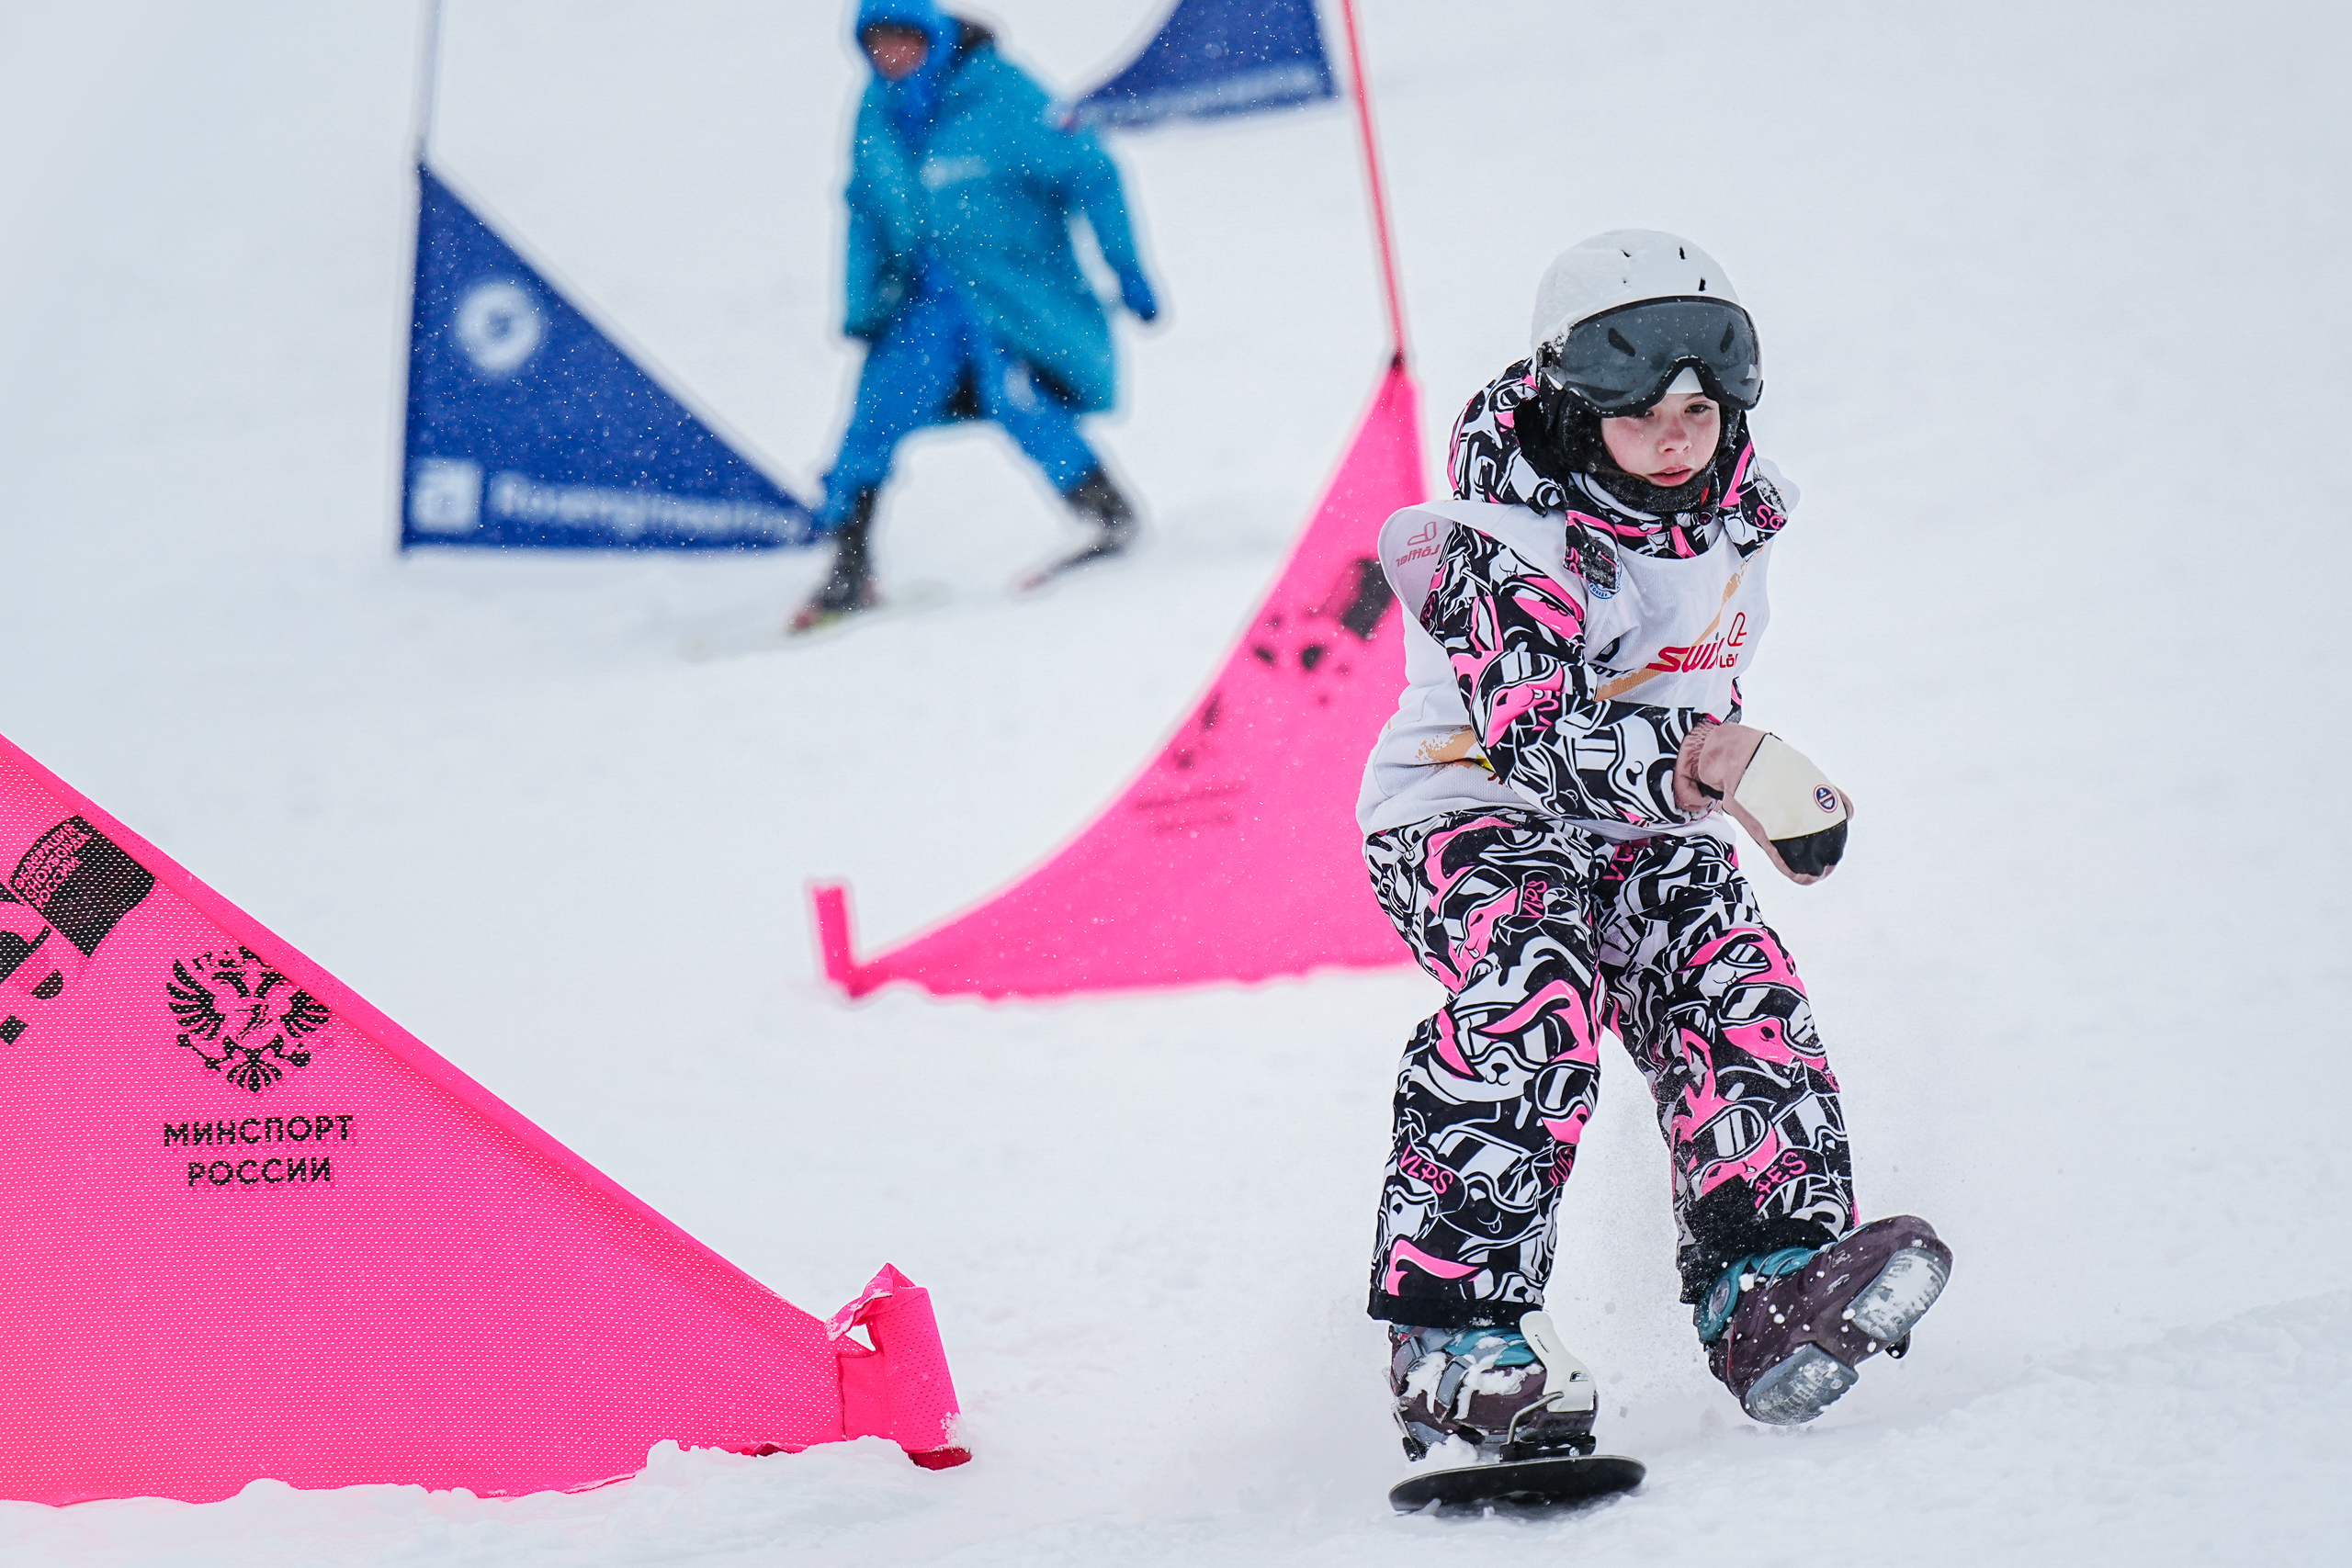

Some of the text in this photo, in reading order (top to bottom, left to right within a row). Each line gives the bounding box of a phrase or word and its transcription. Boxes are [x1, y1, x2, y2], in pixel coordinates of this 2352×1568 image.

[15, 823, 78, 890] ФЕДЕРАЦИЯ
[25, 832, 93, 899] СНОУБОРДА
[34, 856, 82, 910] РОССИИ
[164, 1115, 354, 1147] МИНСПОРТ
[187, 1156, 331, 1187] РОССИИ
